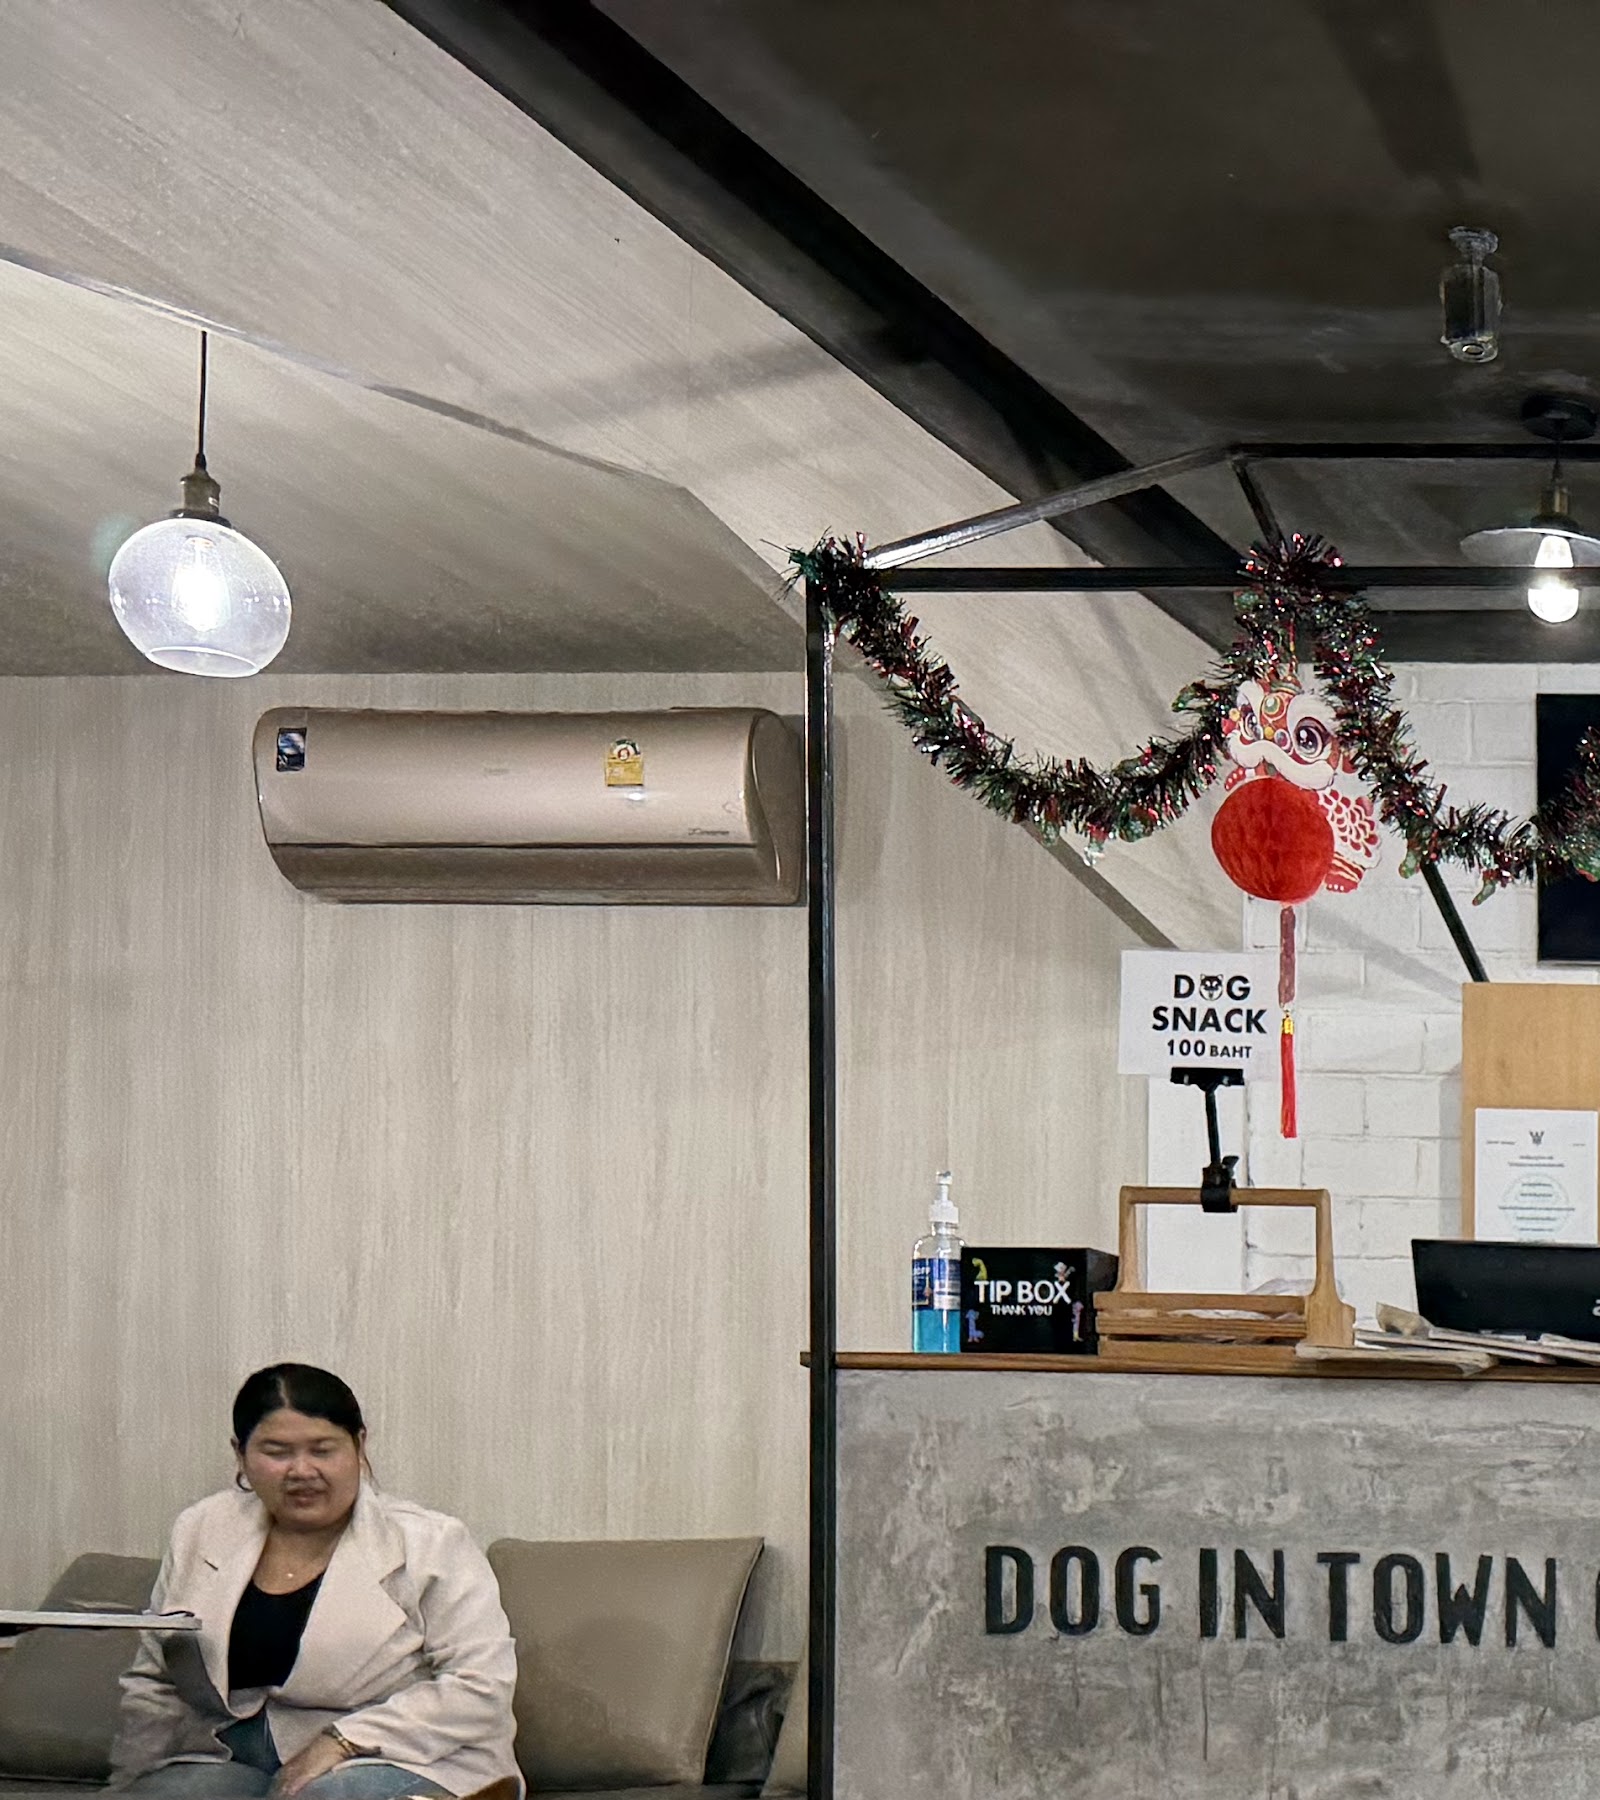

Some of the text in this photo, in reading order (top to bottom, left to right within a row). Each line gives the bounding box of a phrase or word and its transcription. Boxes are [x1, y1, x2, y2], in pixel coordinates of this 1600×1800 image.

[1152, 1005, 1268, 1034] SNACK
[1167, 1039, 1252, 1059] 100 BAHT
[974, 1279, 1072, 1304] TIP BOX
[990, 1304, 1053, 1316] THANK YOU
[984, 1545, 1163, 1637] DOG
[1199, 1547, 1286, 1640] IN
[1317, 1551, 1557, 1648] TOWN
